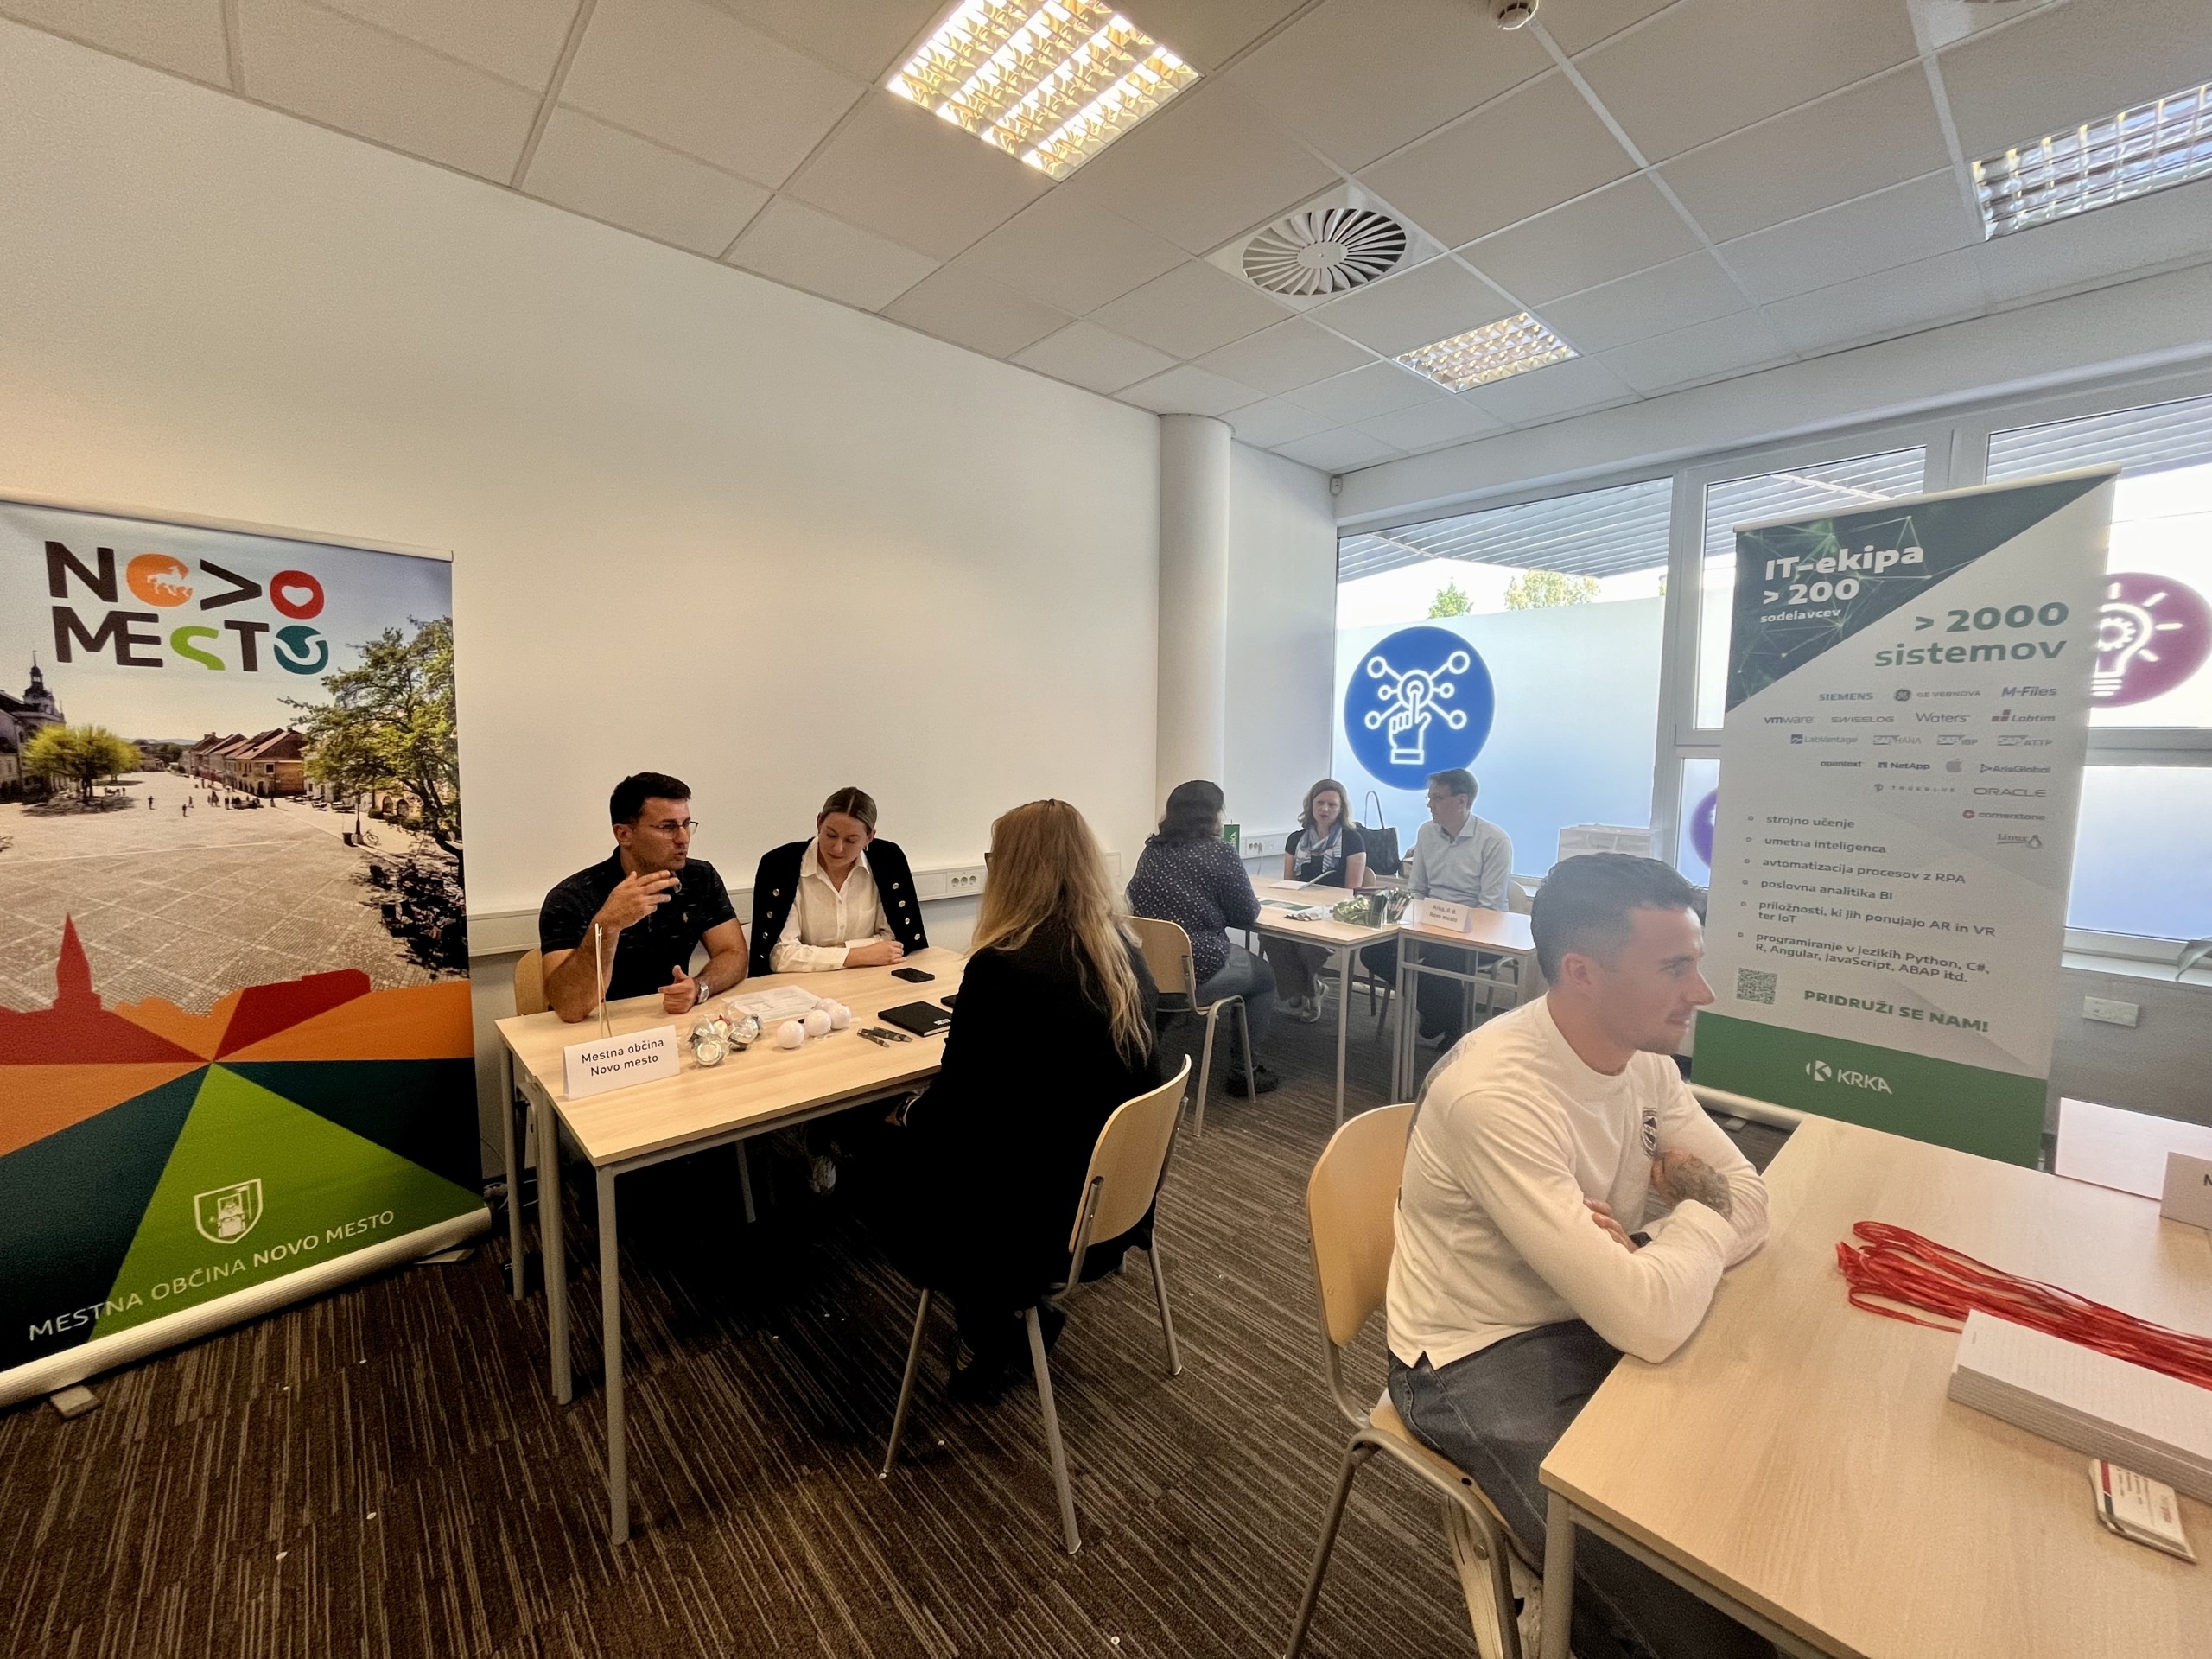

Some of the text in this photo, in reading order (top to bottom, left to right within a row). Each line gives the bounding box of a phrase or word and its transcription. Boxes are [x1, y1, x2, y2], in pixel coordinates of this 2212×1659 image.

[1765, 545, 1923, 581] IT-ekipa
[1788, 578, 1859, 605] 200
[1760, 609, 1841, 623] sodelavcev
[1946, 602, 2069, 632] 2000
[52, 606, 328, 675] MESTO
[1874, 640, 2068, 667] sistemov
[1819, 692, 1873, 701] SIEMENS
[2001, 686, 2057, 697] M-Files
[1916, 712, 1967, 723] Waters
[1891, 761, 1930, 771] NetApp
[1973, 787, 2047, 797] ORACLE
[1766, 816, 1854, 830] strojno učenje
[1764, 838, 1886, 853] umetna inteligenca
[1763, 858, 1853, 874] avtomatizacija
[1858, 866, 1920, 880] procesov
[1936, 873, 1966, 884] RPA
[1761, 880, 1893, 900] poslovna analitika BI
[1758, 912, 1797, 924] ter IoT
[1758, 901, 1995, 938] priložnosti, ki jih ponujajo AR in VR
[1756, 944, 1968, 982] R, Angular, JavaScript, ABAP itd.
[1757, 932, 1843, 951] programiranje
[1857, 945, 1901, 960] jezikih
[1905, 952, 1961, 970] Python,
[1967, 962, 1990, 975] C#,
[1804, 990, 1989, 1033] PRIDRUŽI SE NAM!
[582, 1039, 664, 1064] Mestna občina
[591, 1055, 658, 1077] Novo mesto
[1837, 1068, 1893, 1095] KRKA
[29, 1211, 395, 1341] MESTNA OBČINA NOVO MESTO
